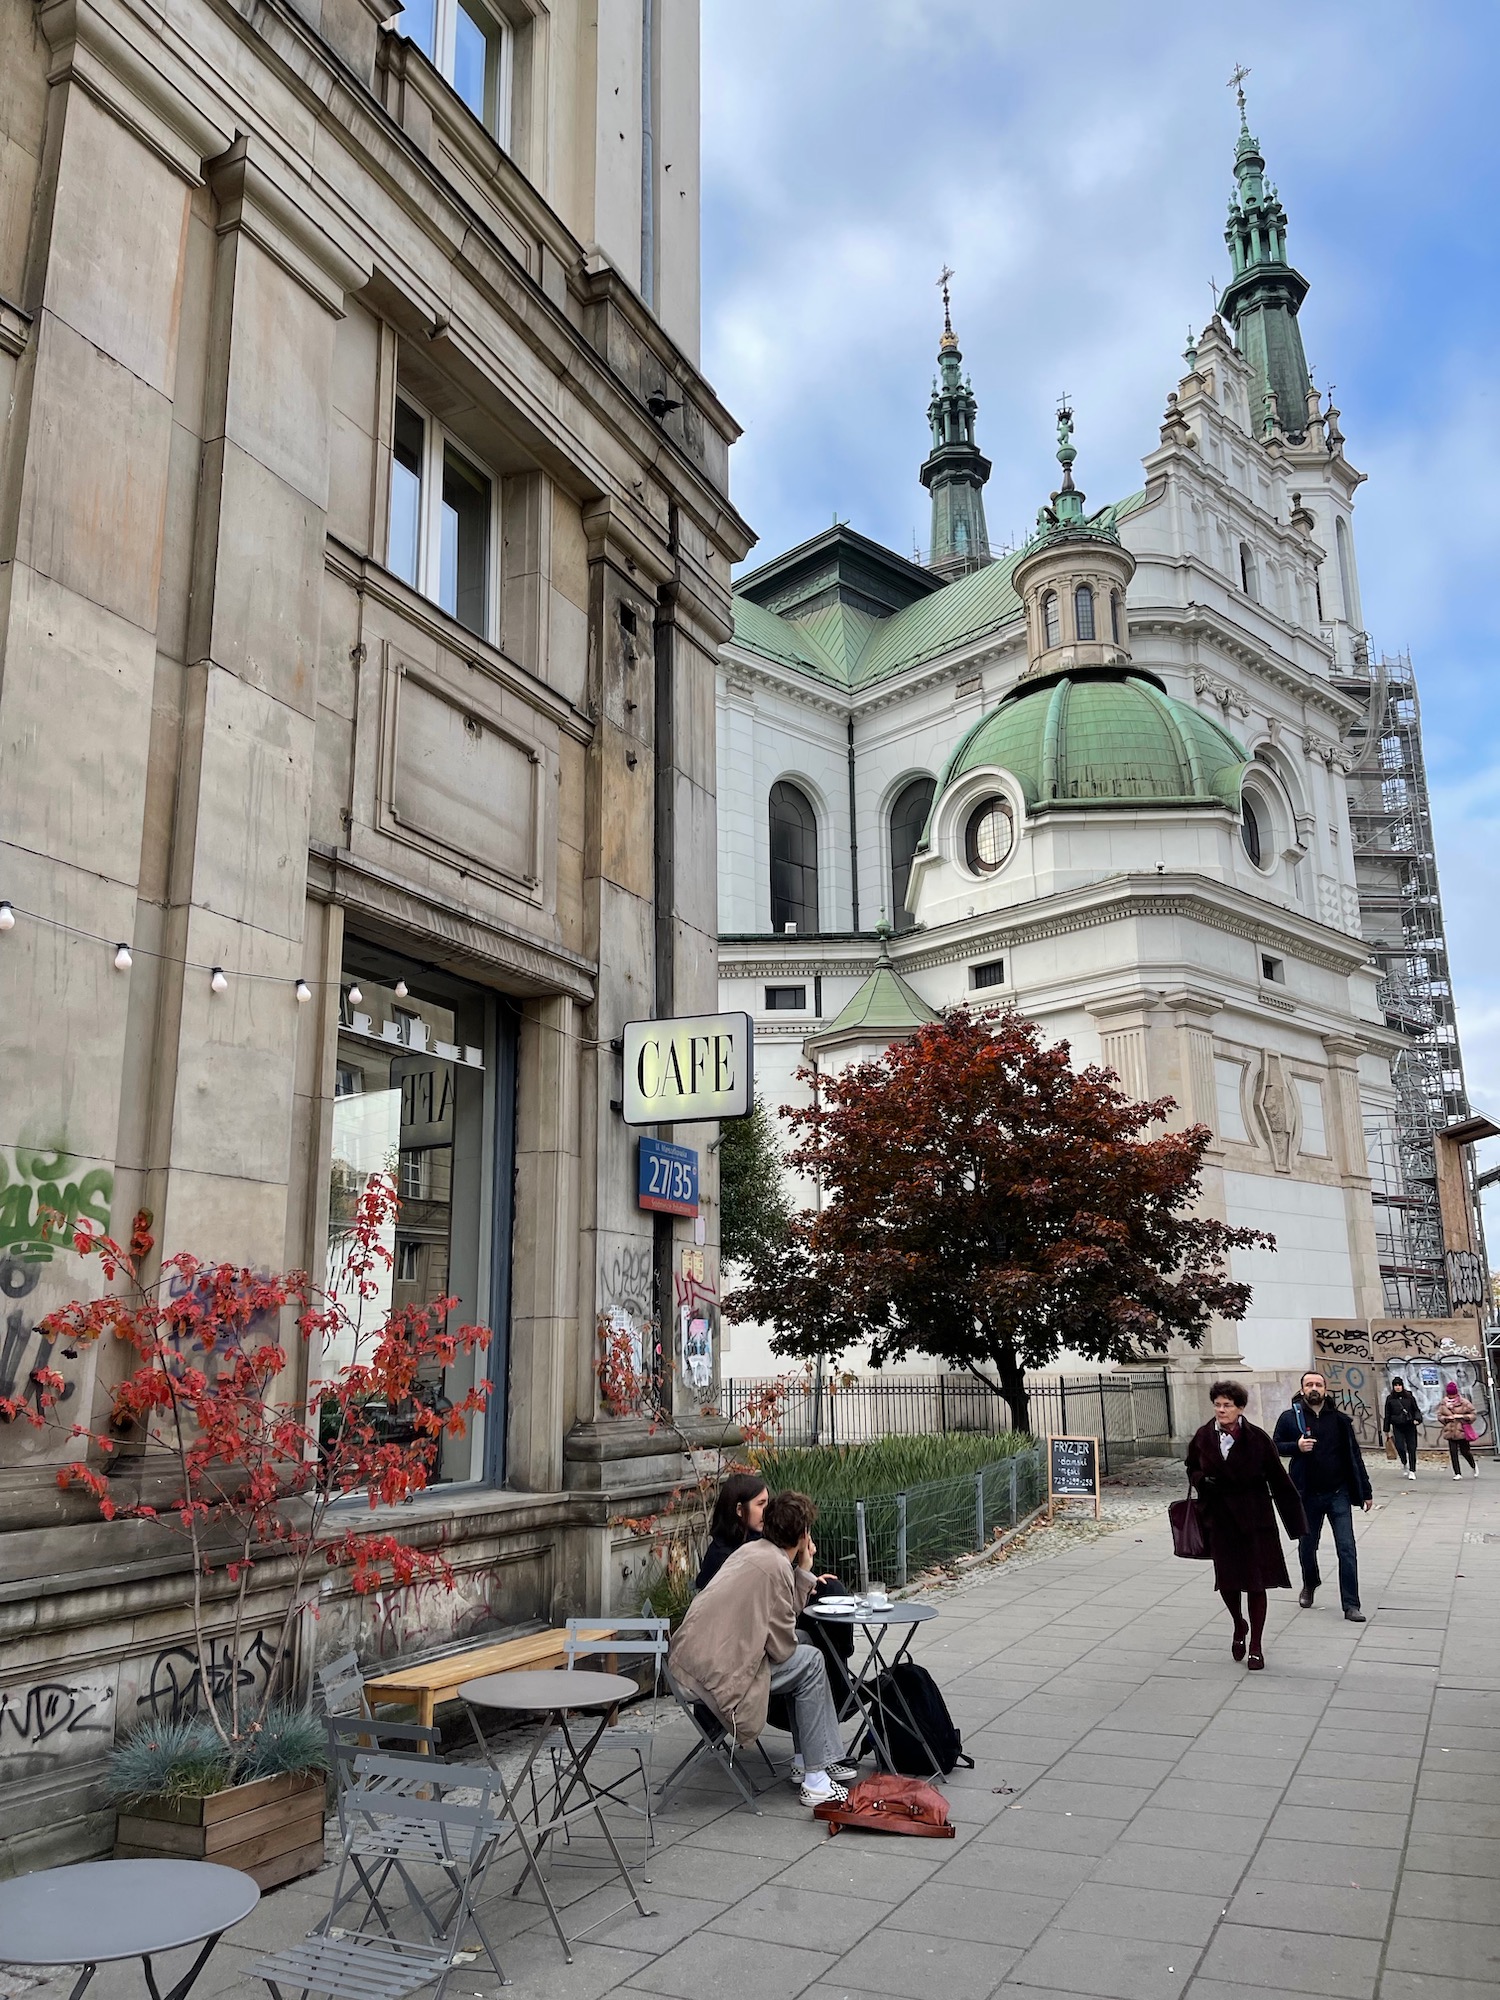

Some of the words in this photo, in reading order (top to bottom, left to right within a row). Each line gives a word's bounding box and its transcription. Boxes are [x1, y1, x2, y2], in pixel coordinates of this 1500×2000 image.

[637, 1034, 735, 1099] CAFE
[648, 1155, 692, 1200] 27/35
[1054, 1441, 1089, 1456] FRYZJER
